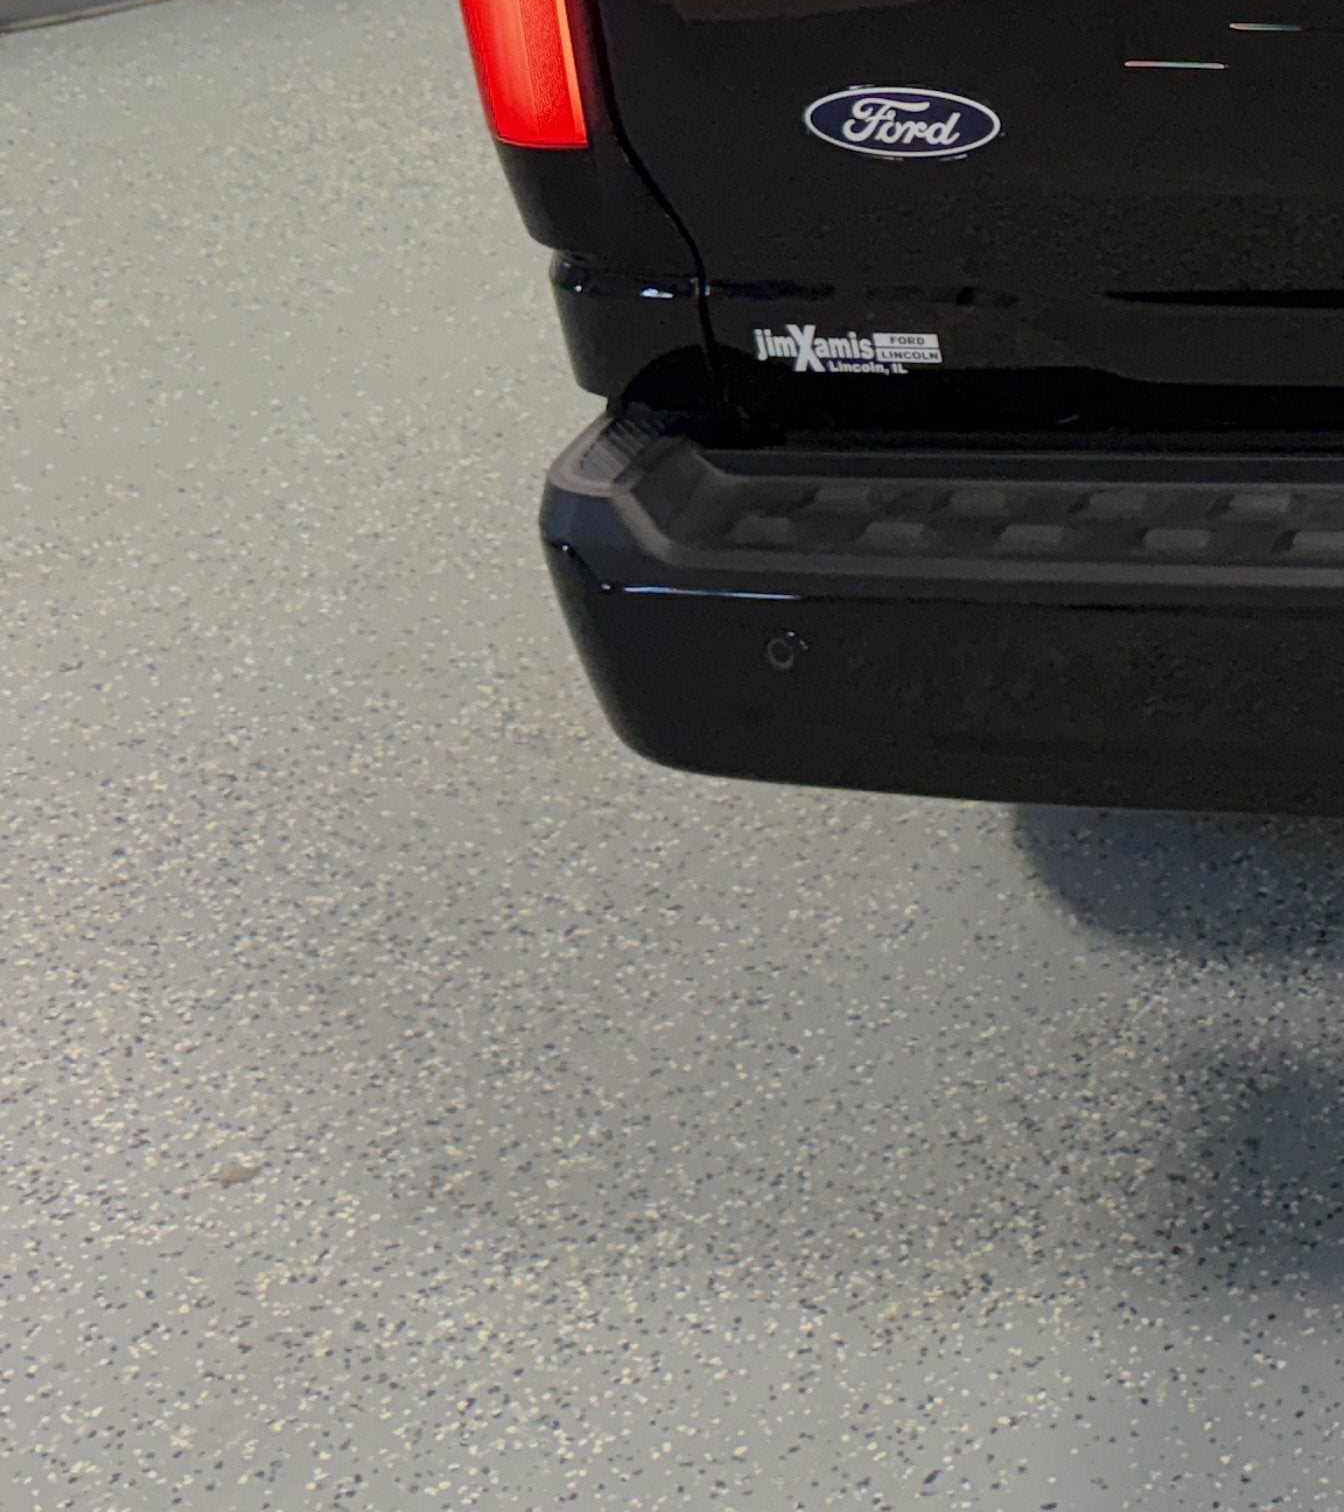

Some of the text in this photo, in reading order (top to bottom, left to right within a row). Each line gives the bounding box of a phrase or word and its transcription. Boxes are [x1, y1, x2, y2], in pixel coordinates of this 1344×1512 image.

[842, 97, 961, 146] Ford
[889, 335, 925, 346] FORD
[880, 349, 940, 361] LINCOLN
[891, 362, 908, 375] IL
